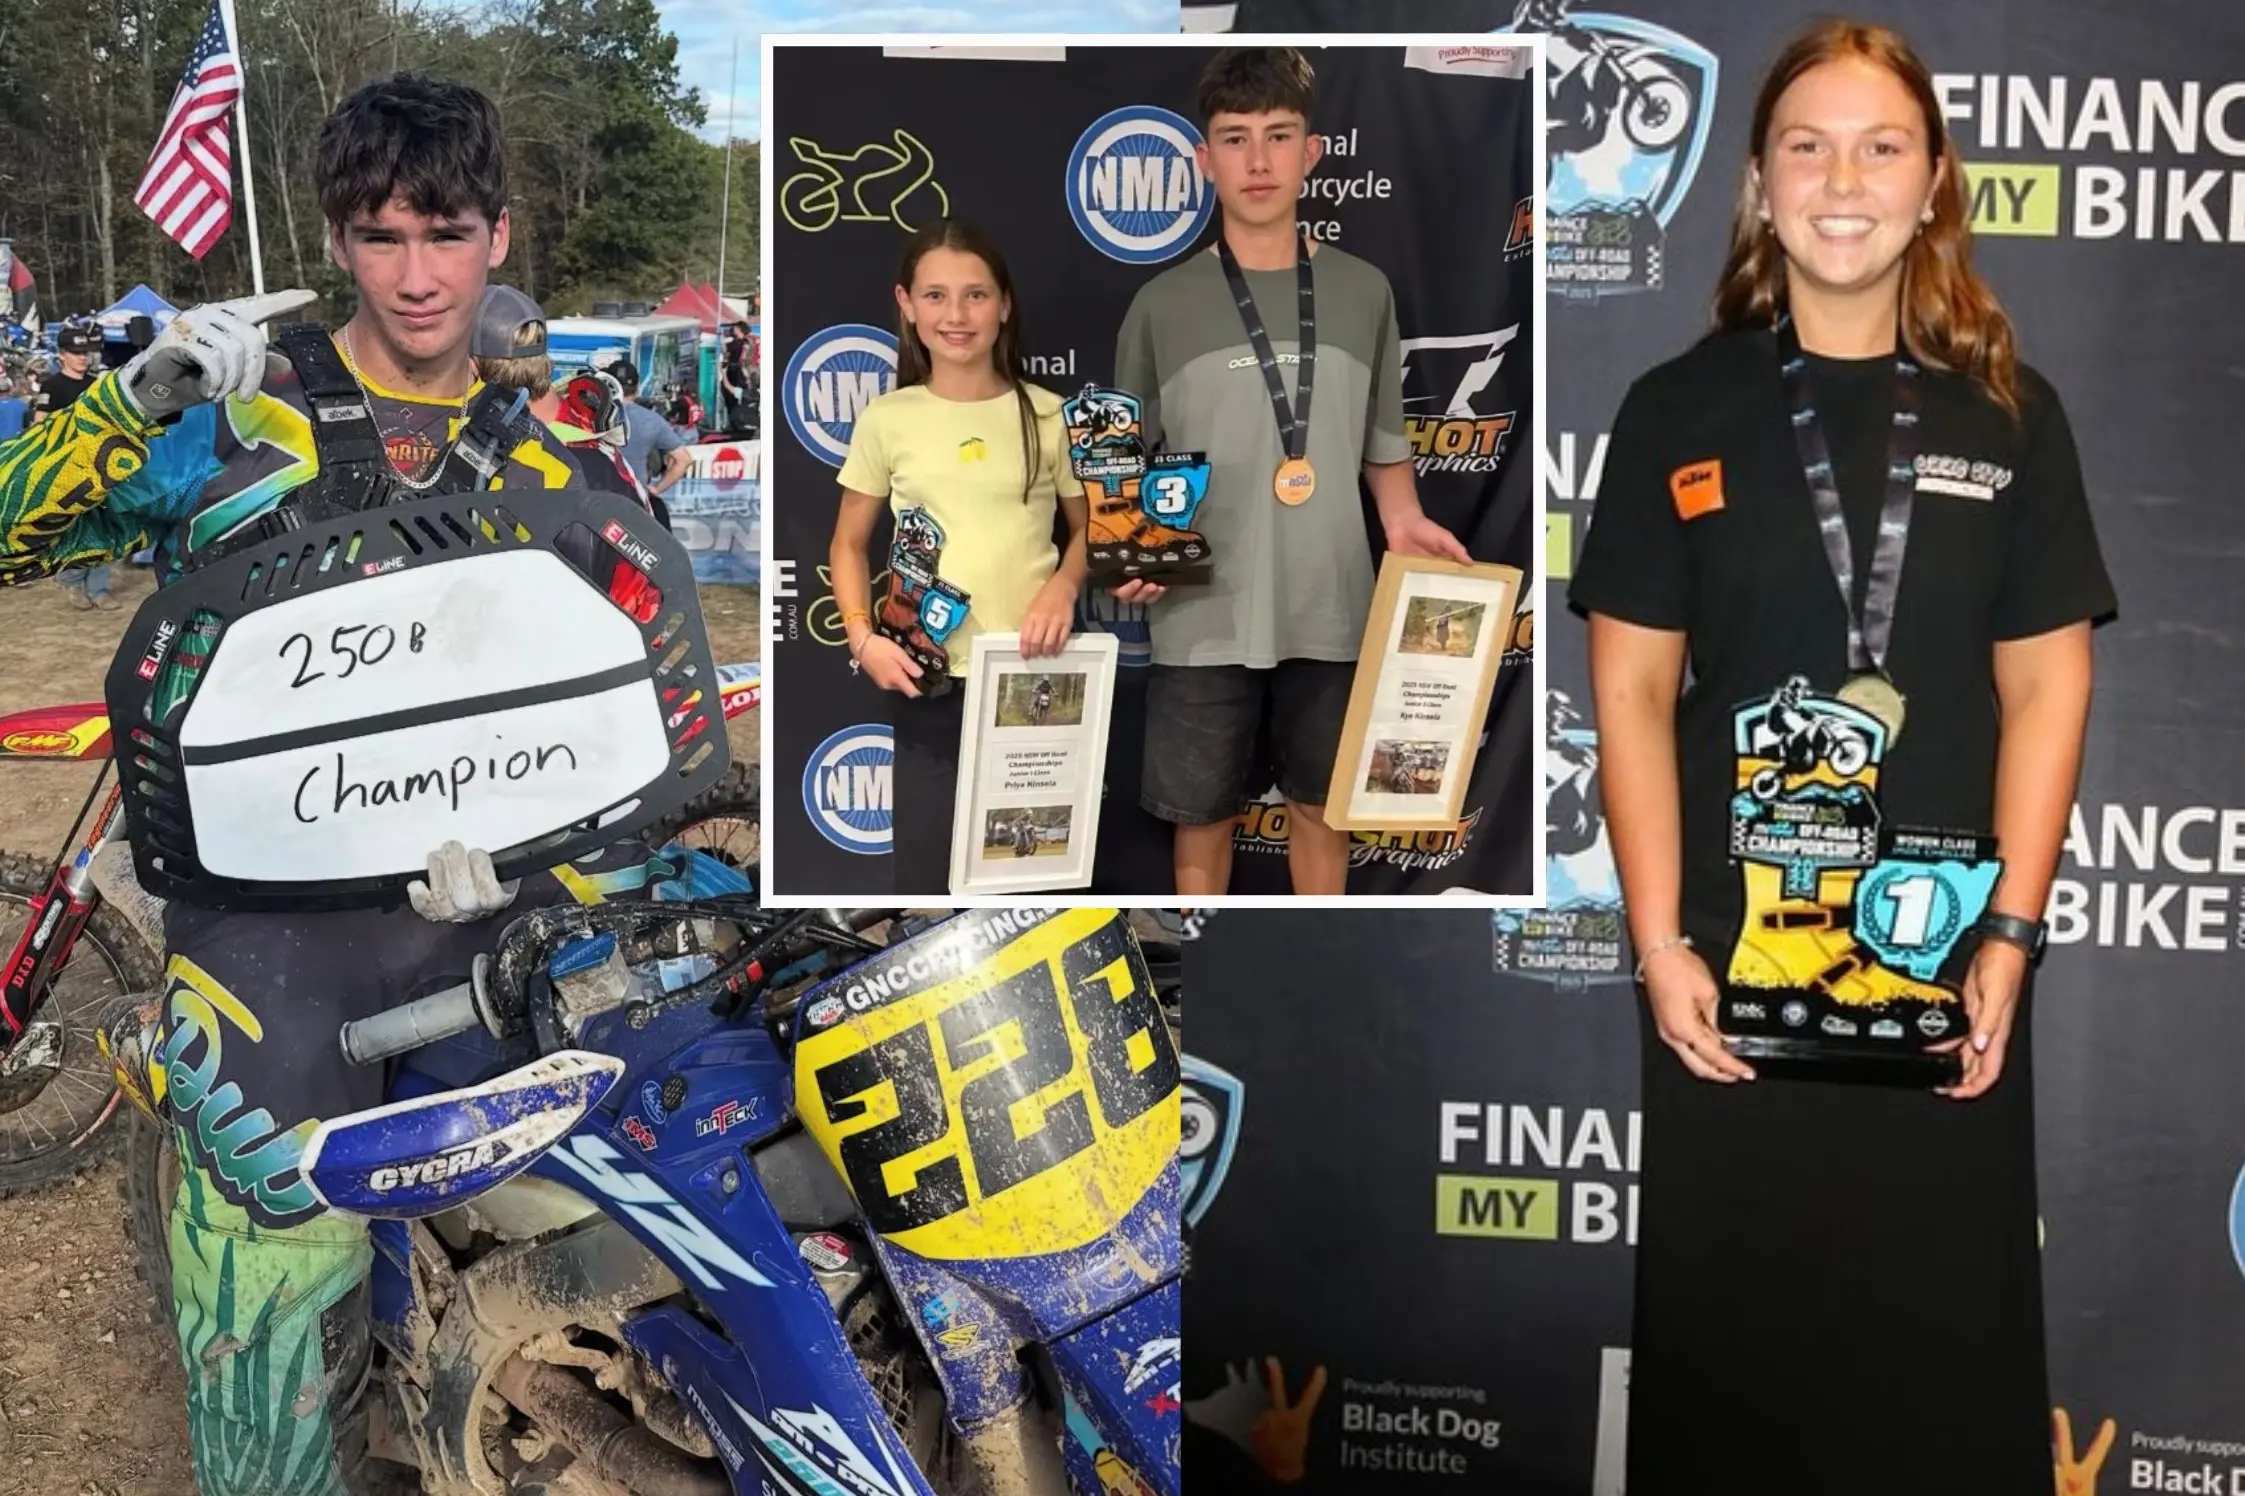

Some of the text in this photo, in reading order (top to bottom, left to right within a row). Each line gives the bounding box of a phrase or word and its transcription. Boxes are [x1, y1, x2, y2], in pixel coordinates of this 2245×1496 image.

[1085, 155, 1202, 212] NMA
[1155, 476, 1187, 514] 3
[925, 597, 952, 630] 5
[279, 622, 396, 689] 250
[293, 735, 578, 823] Champion
[1886, 875, 1936, 946] 1
[2043, 880, 2230, 951] BIKE
[369, 1141, 495, 1192] CYCRA
[1457, 1187, 1538, 1229] MY
[1342, 1402, 1502, 1449] Black Dog
[1341, 1438, 1468, 1475] Institute
[2130, 1458, 2225, 1496] Black
